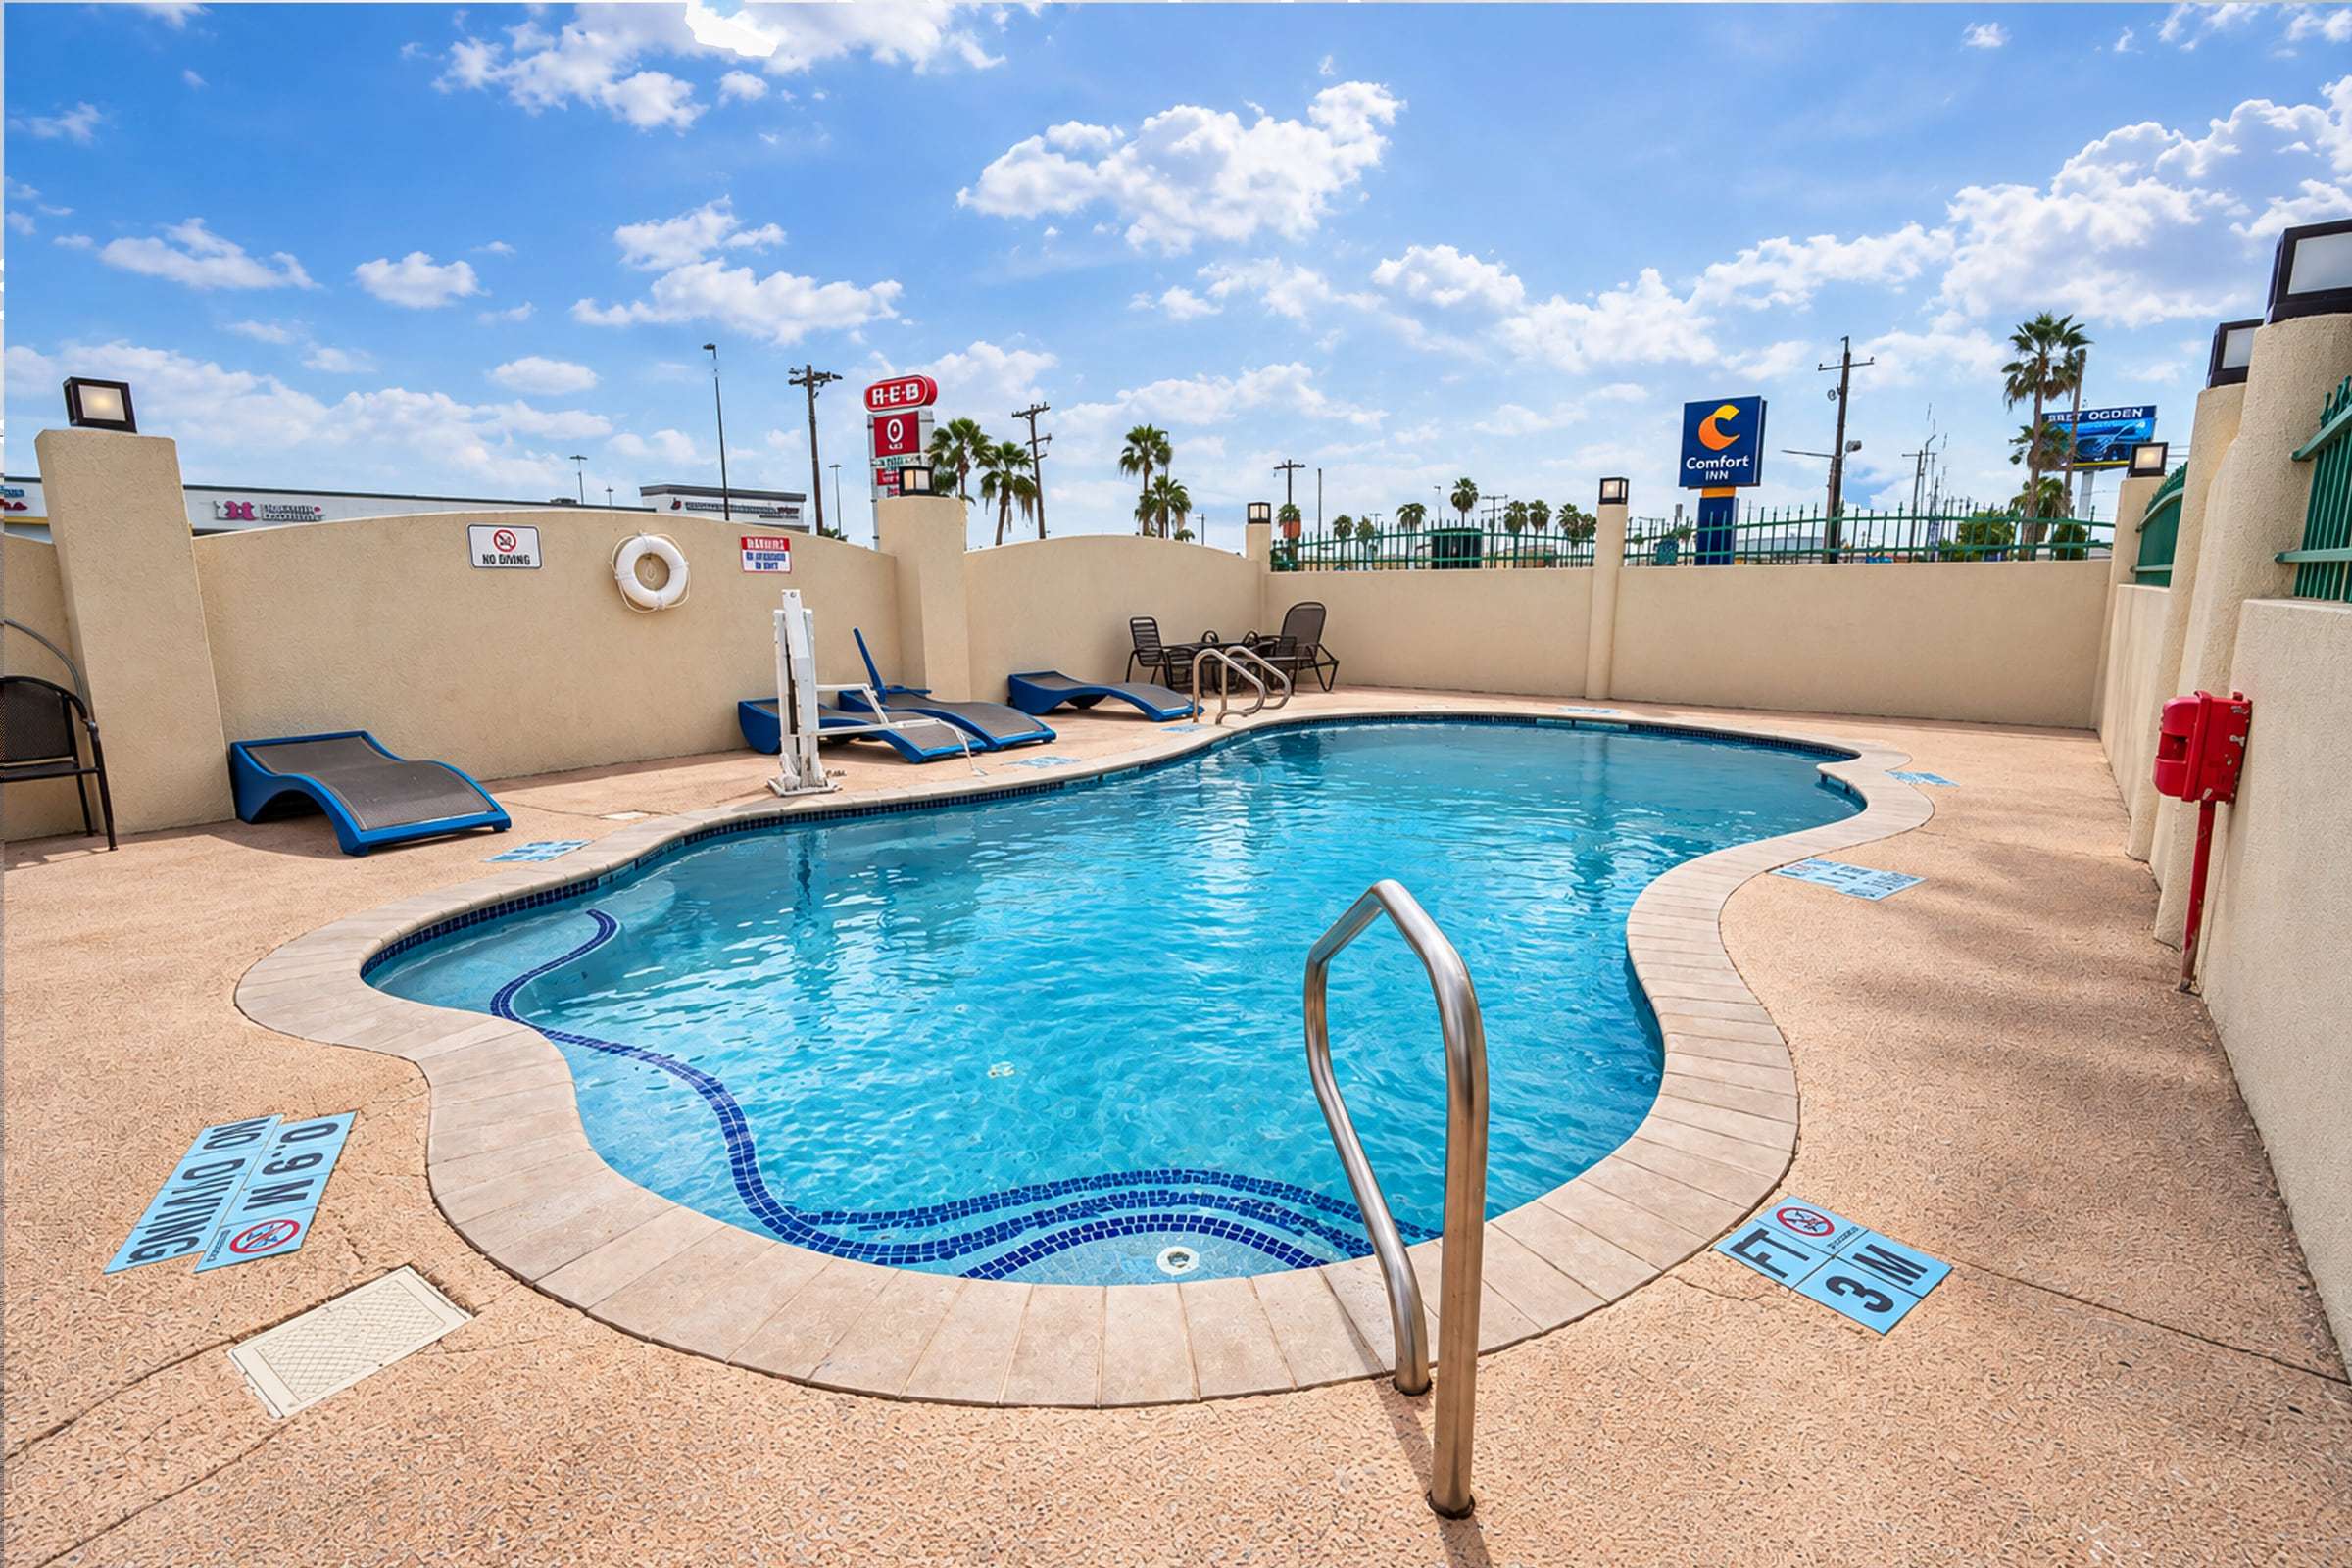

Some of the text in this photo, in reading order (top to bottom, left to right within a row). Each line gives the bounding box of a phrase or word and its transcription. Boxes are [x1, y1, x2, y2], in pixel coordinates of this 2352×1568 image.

[2088, 408, 2144, 420] OGDEN
[1686, 455, 1749, 469] Comfort
[1705, 470, 1729, 481] INN
[482, 554, 496, 565] NO
[1729, 1227, 1811, 1280] FT
[1851, 1243, 1929, 1286] M
[1825, 1275, 1895, 1314] 3
